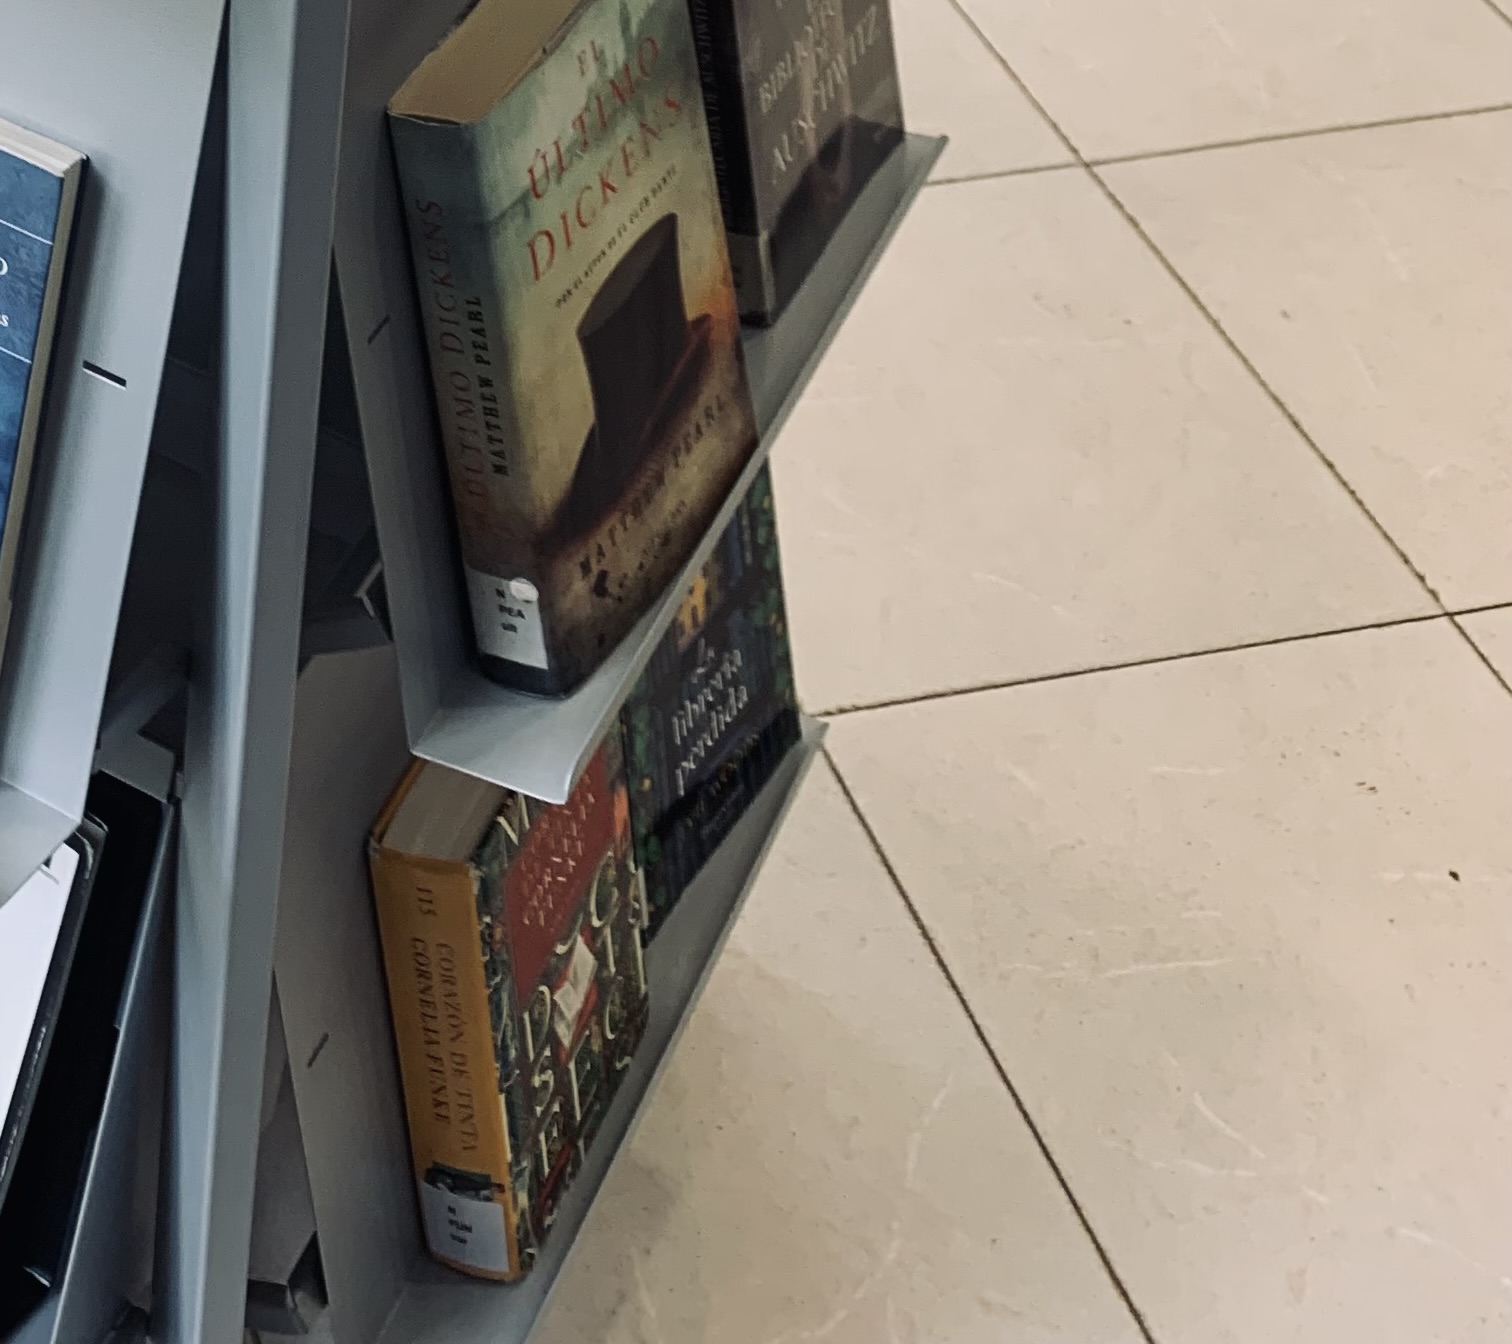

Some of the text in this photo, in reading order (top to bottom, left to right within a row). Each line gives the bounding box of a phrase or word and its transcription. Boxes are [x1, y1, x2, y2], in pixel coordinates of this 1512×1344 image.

[526, 89, 683, 282] DICKENS
[527, 36, 660, 201] ÚLTIMO
[465, 294, 510, 476] MATTHEW PEARL
